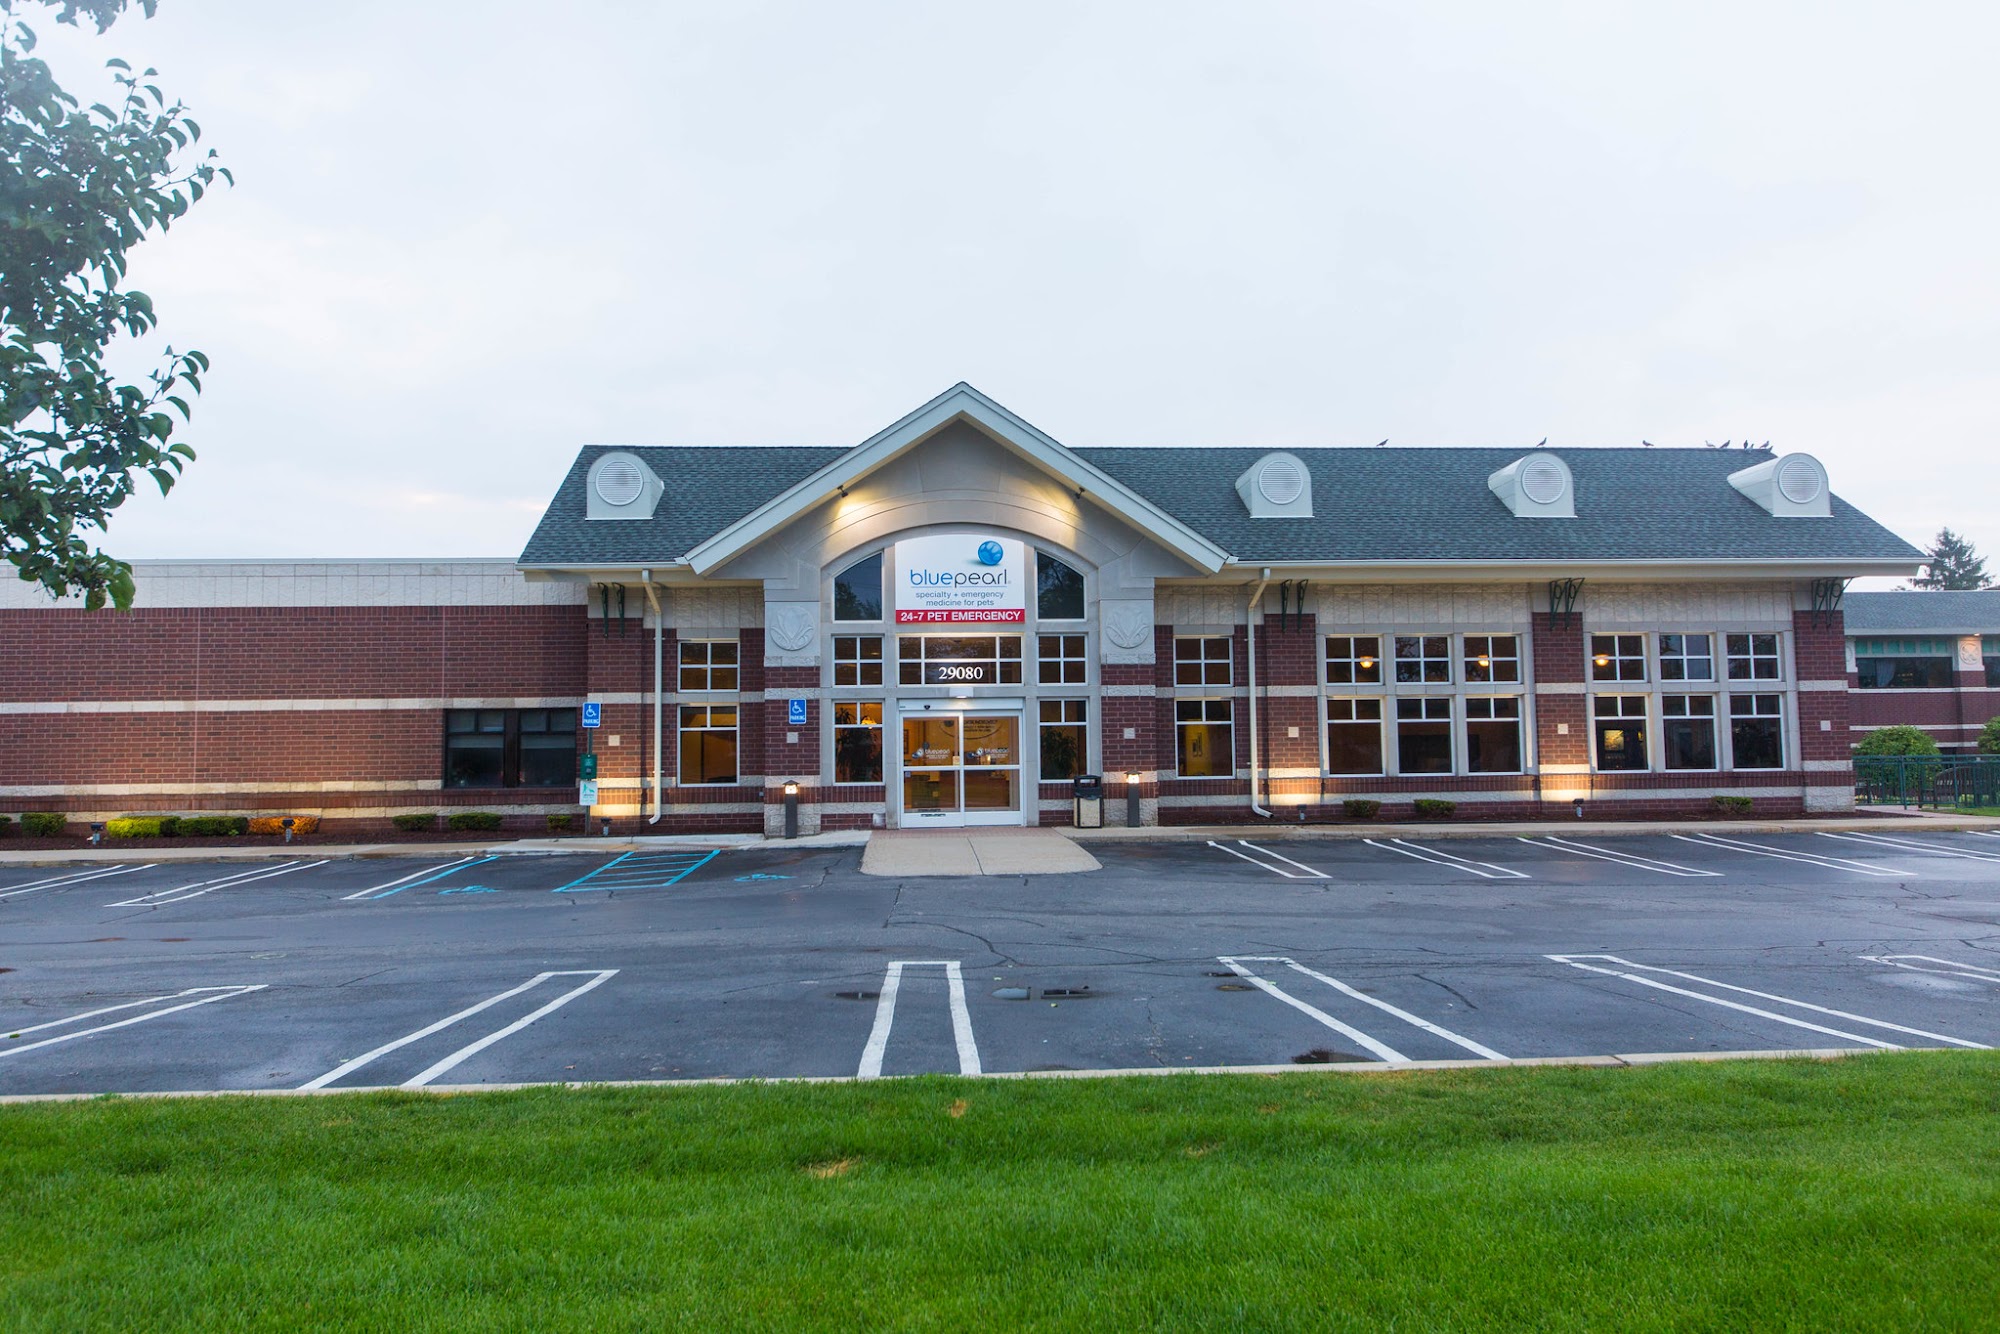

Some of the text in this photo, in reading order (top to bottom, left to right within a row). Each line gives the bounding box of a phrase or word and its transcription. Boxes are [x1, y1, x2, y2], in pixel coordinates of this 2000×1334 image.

[910, 569, 1007, 588] bluepearl
[915, 591, 952, 599] specialty
[900, 610, 1021, 621] 24-7 PET EMERGENCY
[938, 666, 984, 680] 29080
